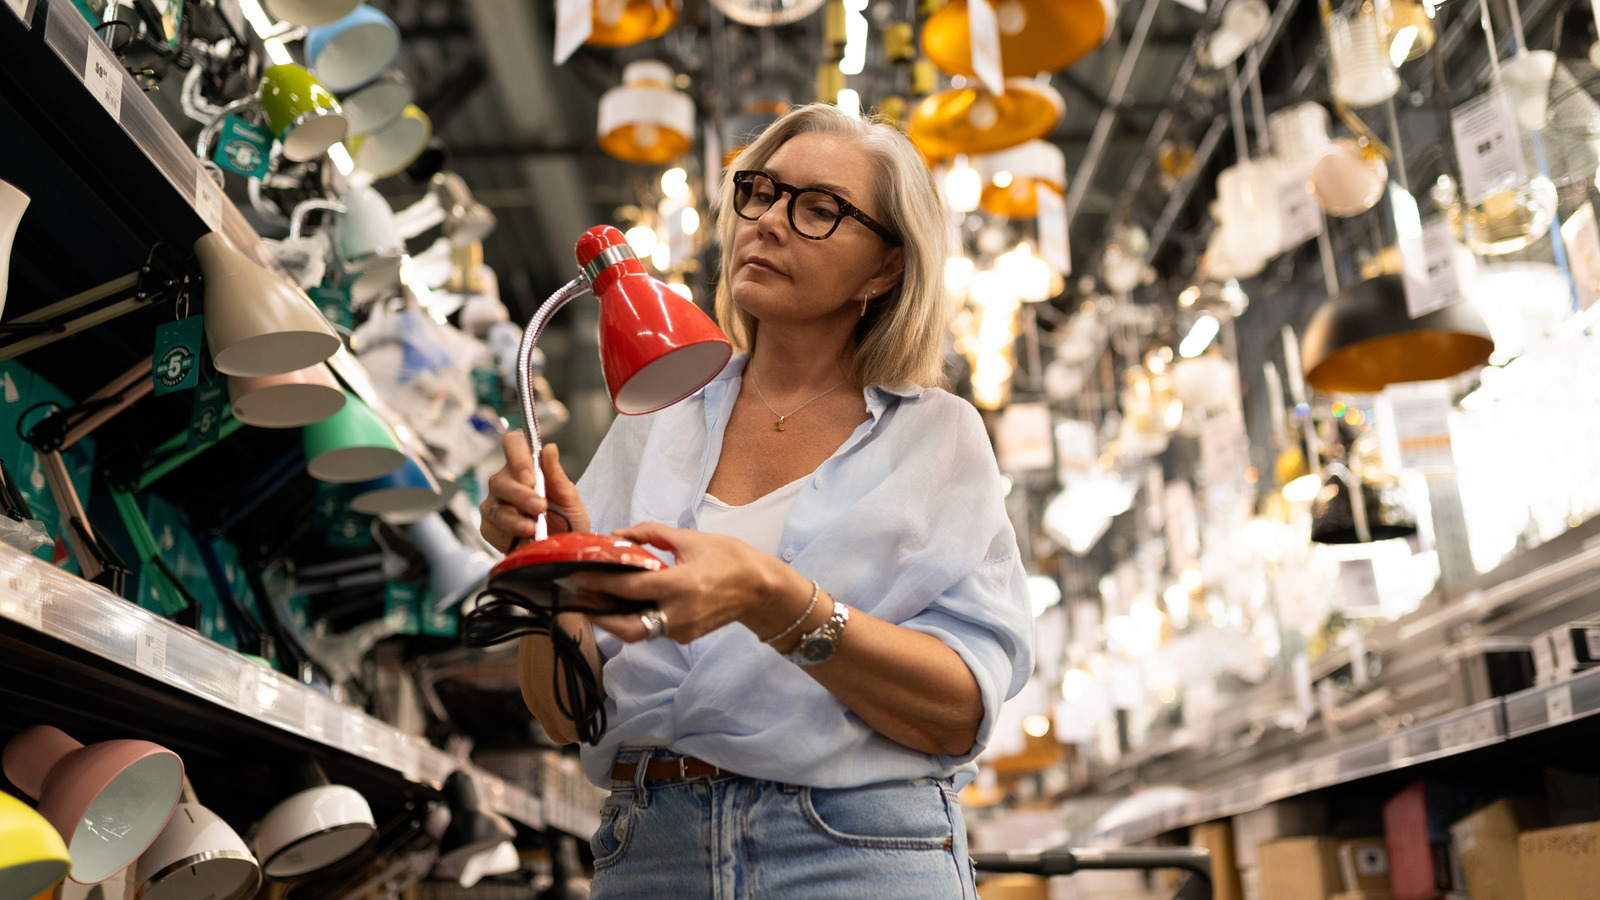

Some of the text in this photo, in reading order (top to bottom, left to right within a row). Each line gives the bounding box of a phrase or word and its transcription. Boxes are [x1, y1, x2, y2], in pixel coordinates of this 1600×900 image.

[168, 355, 182, 378] 5
[182, 359, 191, 367] ЛЕТ
[200, 412, 211, 433] 5
